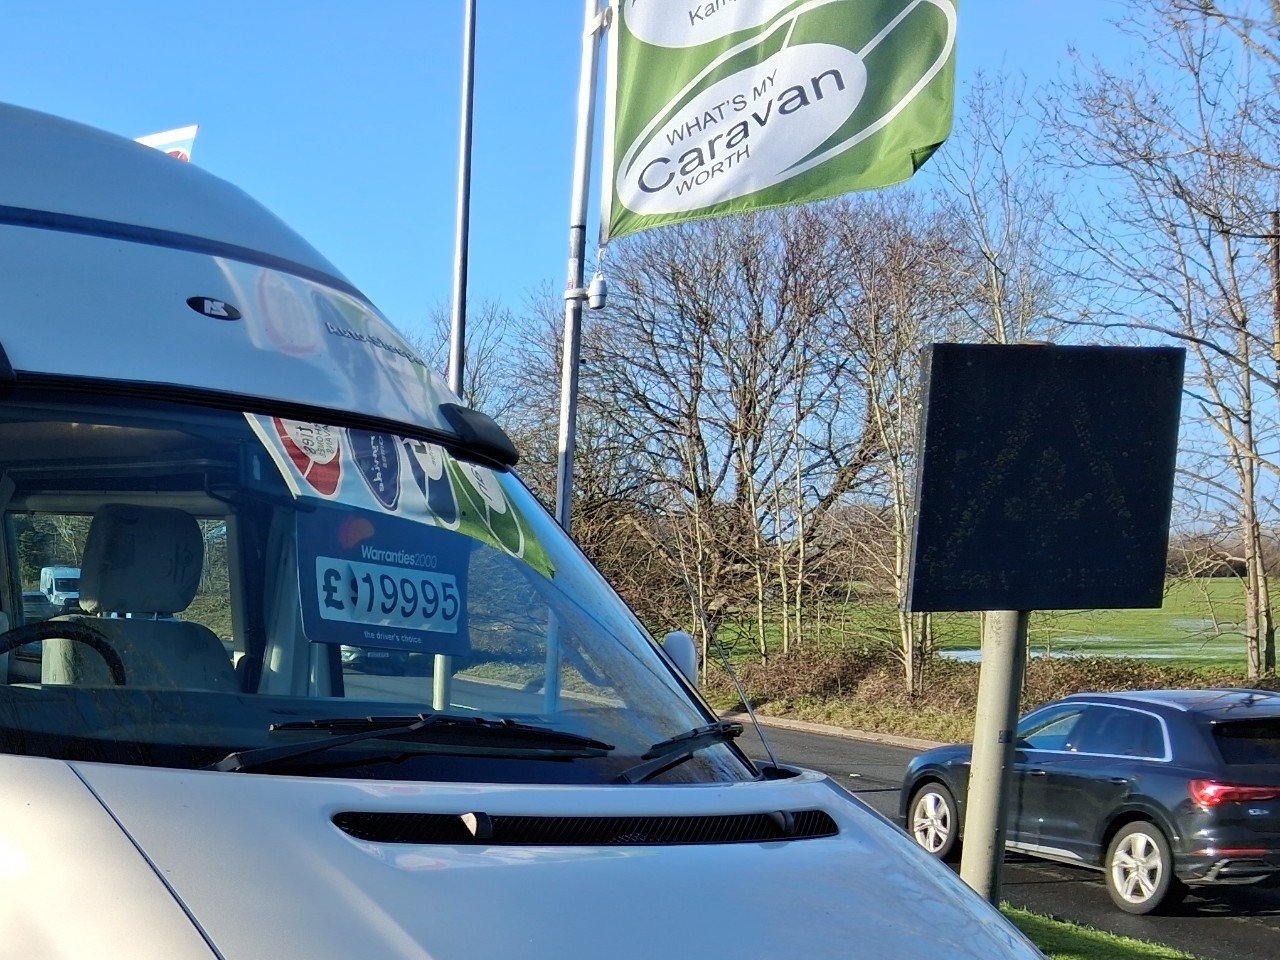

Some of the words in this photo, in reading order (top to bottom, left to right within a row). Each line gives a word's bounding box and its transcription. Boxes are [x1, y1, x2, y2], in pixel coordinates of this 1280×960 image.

[637, 68, 846, 193] Caravan
[666, 94, 748, 146] WHAT'S
[752, 68, 778, 100] MY
[675, 144, 751, 196] WORTH
[360, 544, 438, 569] Warranties2000
[363, 630, 375, 639] the
[377, 630, 400, 641] driver's
[401, 633, 422, 644] choice
